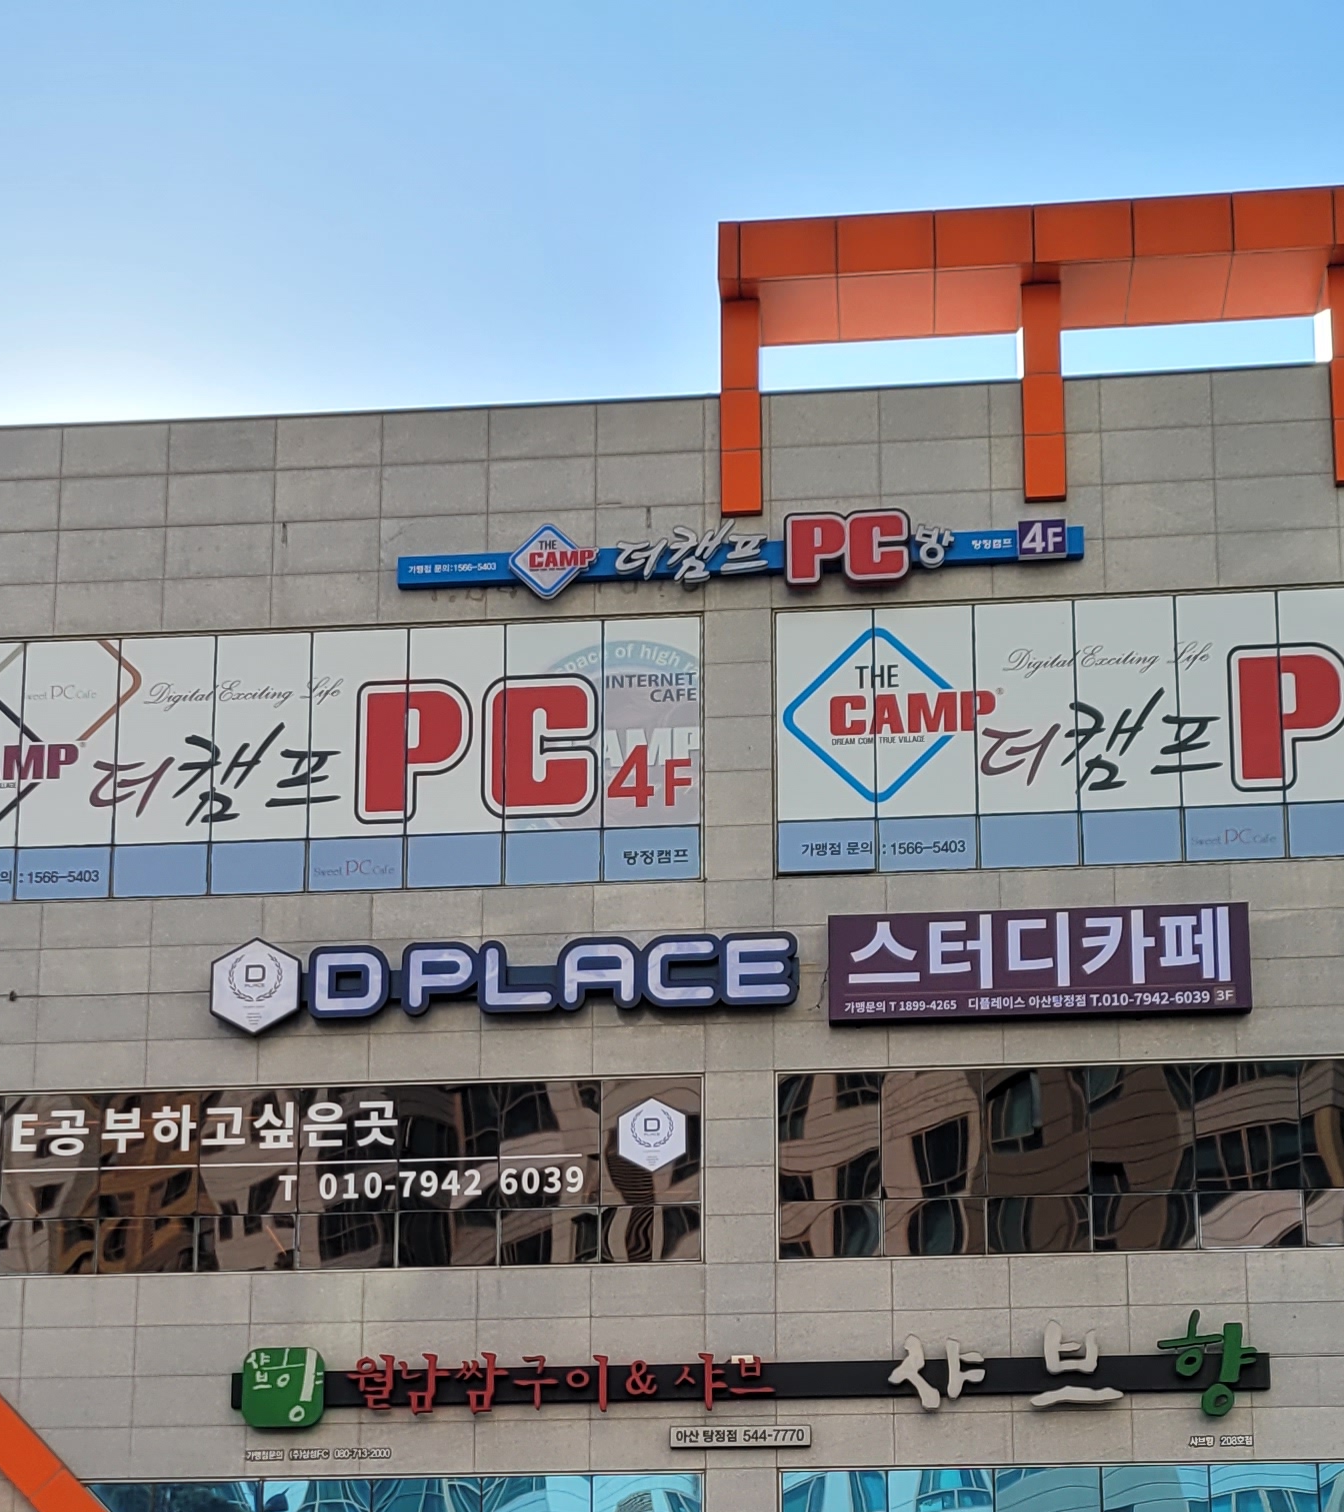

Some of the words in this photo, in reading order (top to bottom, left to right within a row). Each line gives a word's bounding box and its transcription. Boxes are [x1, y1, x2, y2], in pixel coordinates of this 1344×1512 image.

[538, 539, 558, 550] THE
[616, 518, 768, 585] 더캠프
[1021, 521, 1064, 553] 4F
[529, 549, 596, 569] CAMP
[615, 643, 635, 659] of
[639, 644, 682, 669] high
[1002, 648, 1077, 679] Digital
[1080, 645, 1161, 674] Exciting
[1166, 642, 1214, 674] Life
[605, 672, 698, 689] INTERNET
[854, 663, 900, 689] THE
[144, 682, 213, 711] Digital
[218, 679, 295, 705] Exciting
[650, 687, 698, 703] CAFE
[829, 690, 997, 737] CAMP
[89, 722, 343, 827] 더캠프
[354, 673, 599, 825] PC
[831, 737, 856, 746] DREAM
[878, 736, 897, 745] TRUE
[898, 735, 926, 744] VILLAGE
[980, 686, 1224, 796] 더캠프
[606, 743, 694, 809] 4F
[801, 842, 842, 857] 가맹점
[846, 840, 874, 855] 문의
[1223, 828, 1253, 846] PC
[345, 859, 373, 877] PC
[623, 847, 690, 866] 탕정캠프
[847, 905, 1233, 990] 스터디카페
[844, 1001, 888, 1015] 가맹문의
[889, 1001, 897, 1013] T
[898, 999, 958, 1013] 1899-4265
[968, 996, 1026, 1011] 디플레이스
[1028, 994, 1088, 1010] 아산탕정점
[1089, 990, 1211, 1008] T.010-7942-6039
[1215, 988, 1235, 1002] 3F
[278, 1174, 296, 1202] T
[887, 1308, 1259, 1418] 샤브향
[625, 1359, 658, 1396] &
[674, 1352, 776, 1411] 샤브
[675, 1430, 701, 1443] 아산
[702, 1429, 738, 1443] 탕정점
[742, 1428, 806, 1443] 544-7770
